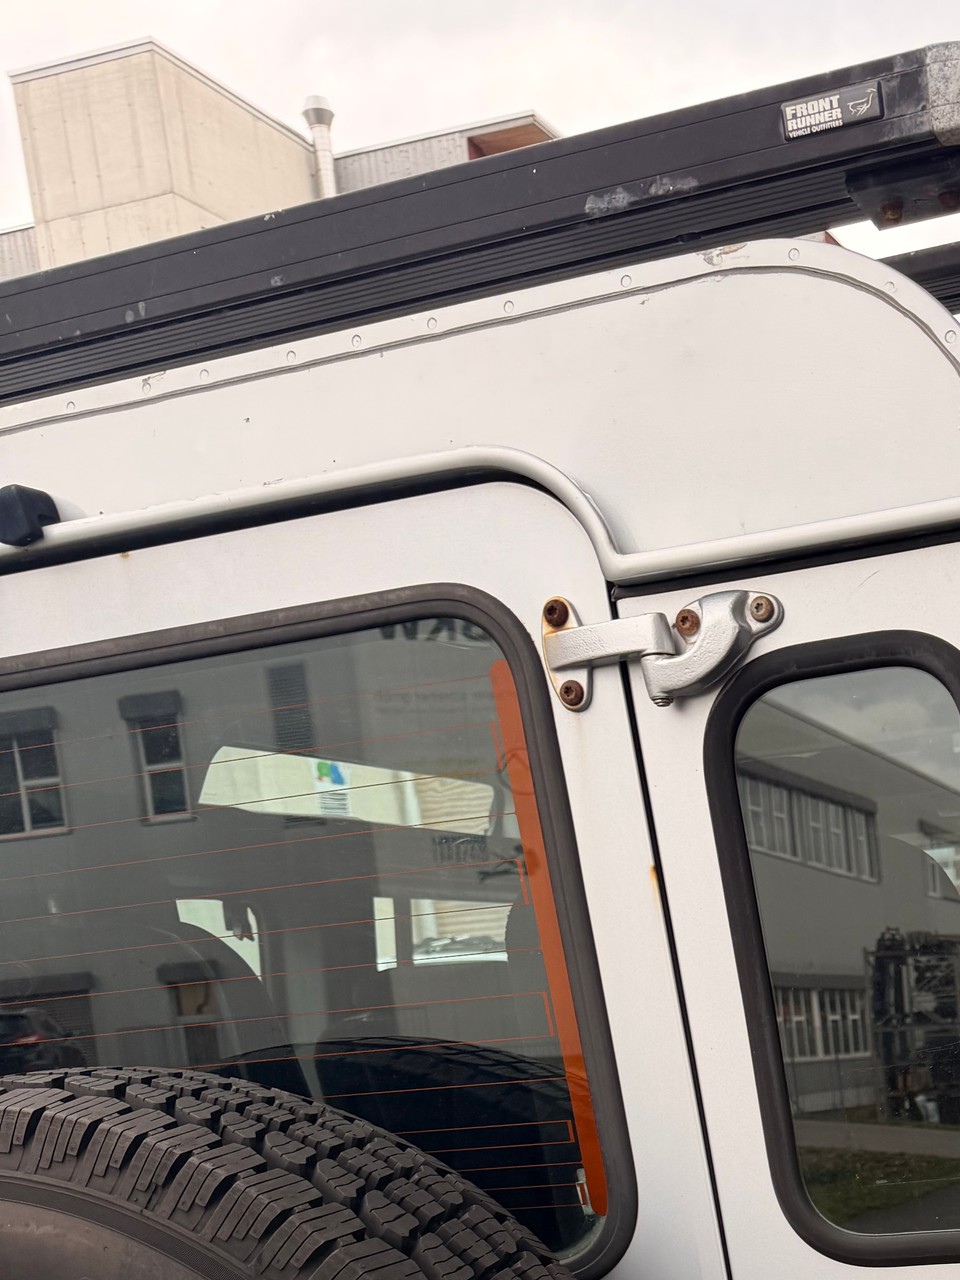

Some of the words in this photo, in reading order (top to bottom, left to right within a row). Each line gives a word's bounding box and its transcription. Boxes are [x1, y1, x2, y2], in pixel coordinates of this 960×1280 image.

[785, 95, 840, 120] FRONT
[787, 108, 842, 131] RUNNER
[788, 127, 811, 139] VEHICLE
[811, 119, 843, 133] OUTFITTERS
